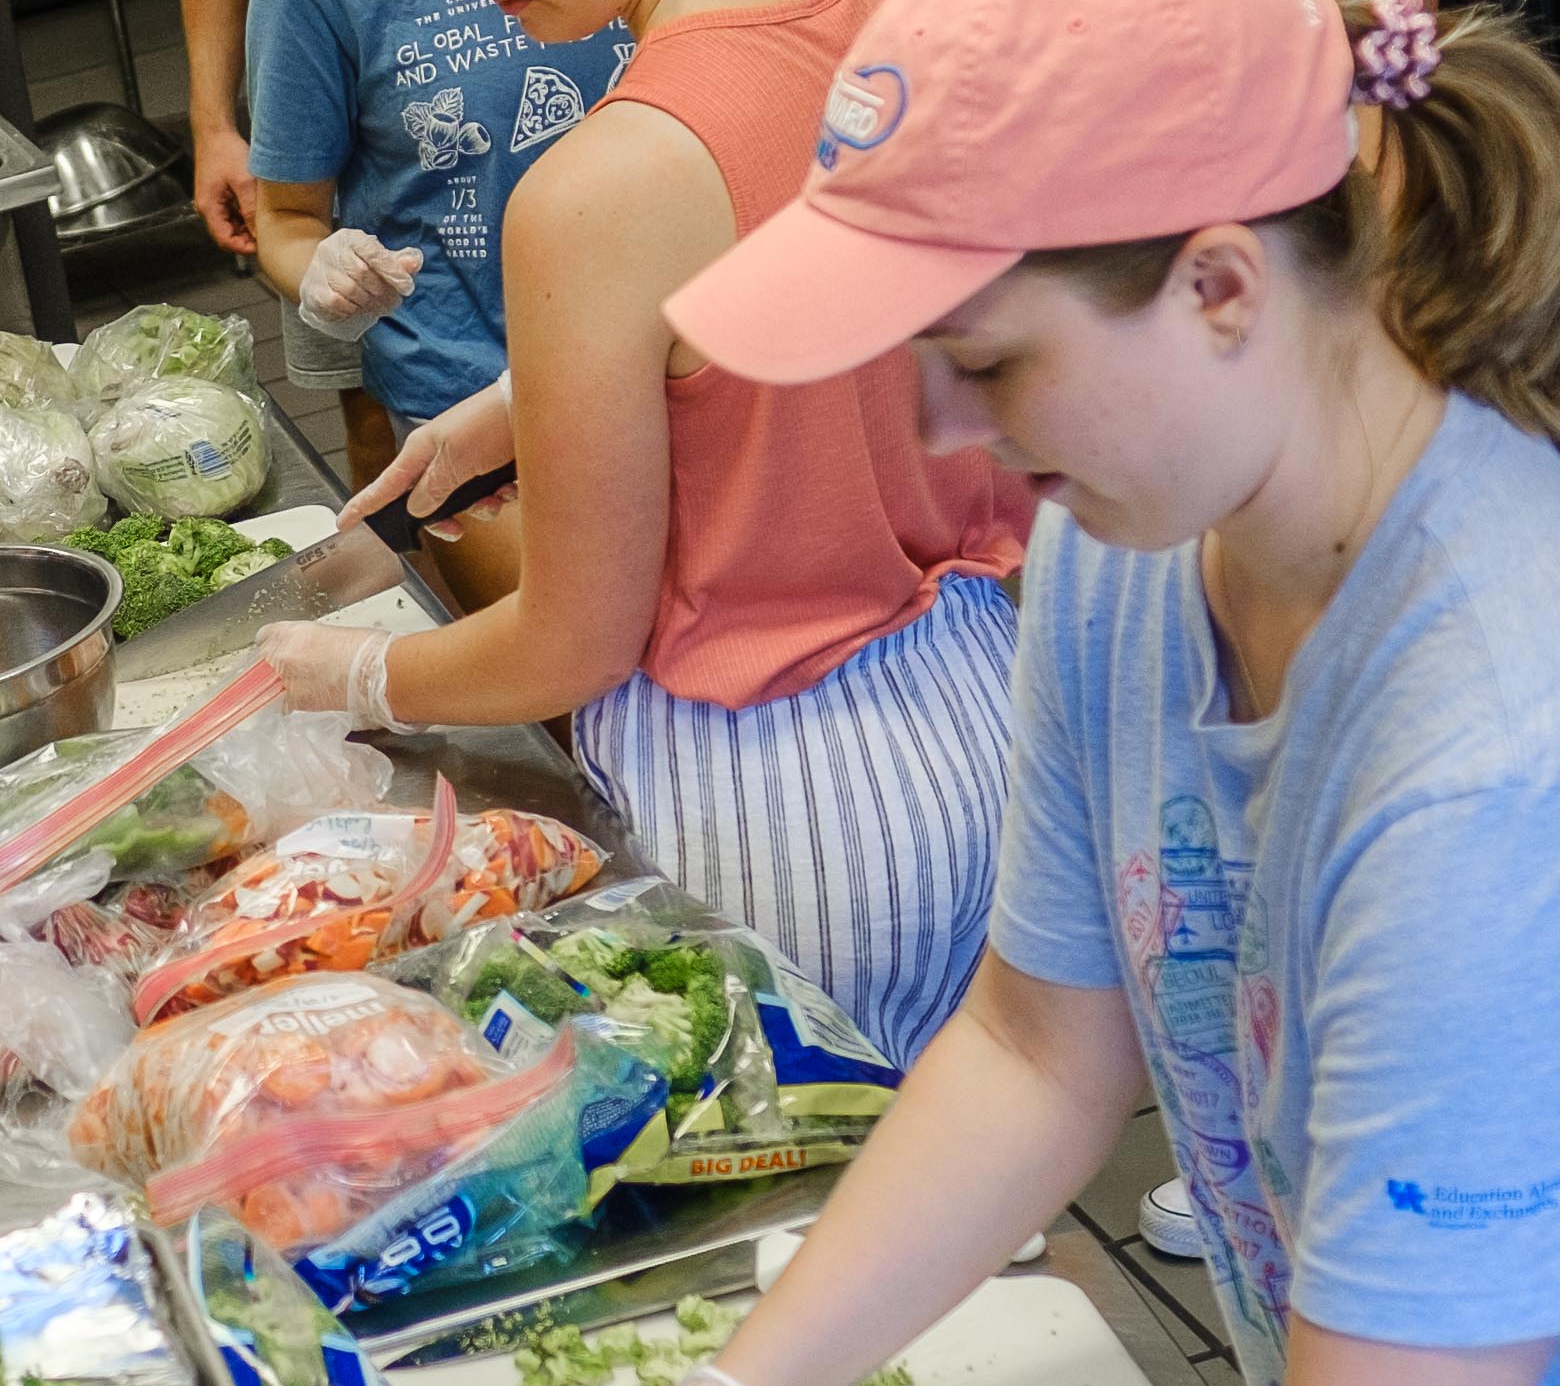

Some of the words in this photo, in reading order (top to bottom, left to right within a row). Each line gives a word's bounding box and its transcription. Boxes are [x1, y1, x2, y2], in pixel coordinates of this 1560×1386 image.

[414, 12, 441, 27] THE
[396, 23, 494, 66] GLOBAL
[396, 63, 438, 89] AND
[446, 34, 528, 75] WASTE
[690, 1155, 732, 1177] BIG
[738, 1147, 808, 1174] DEAL!
[1434, 1185, 1524, 1204] Education
[1431, 1205, 1465, 1222] and
